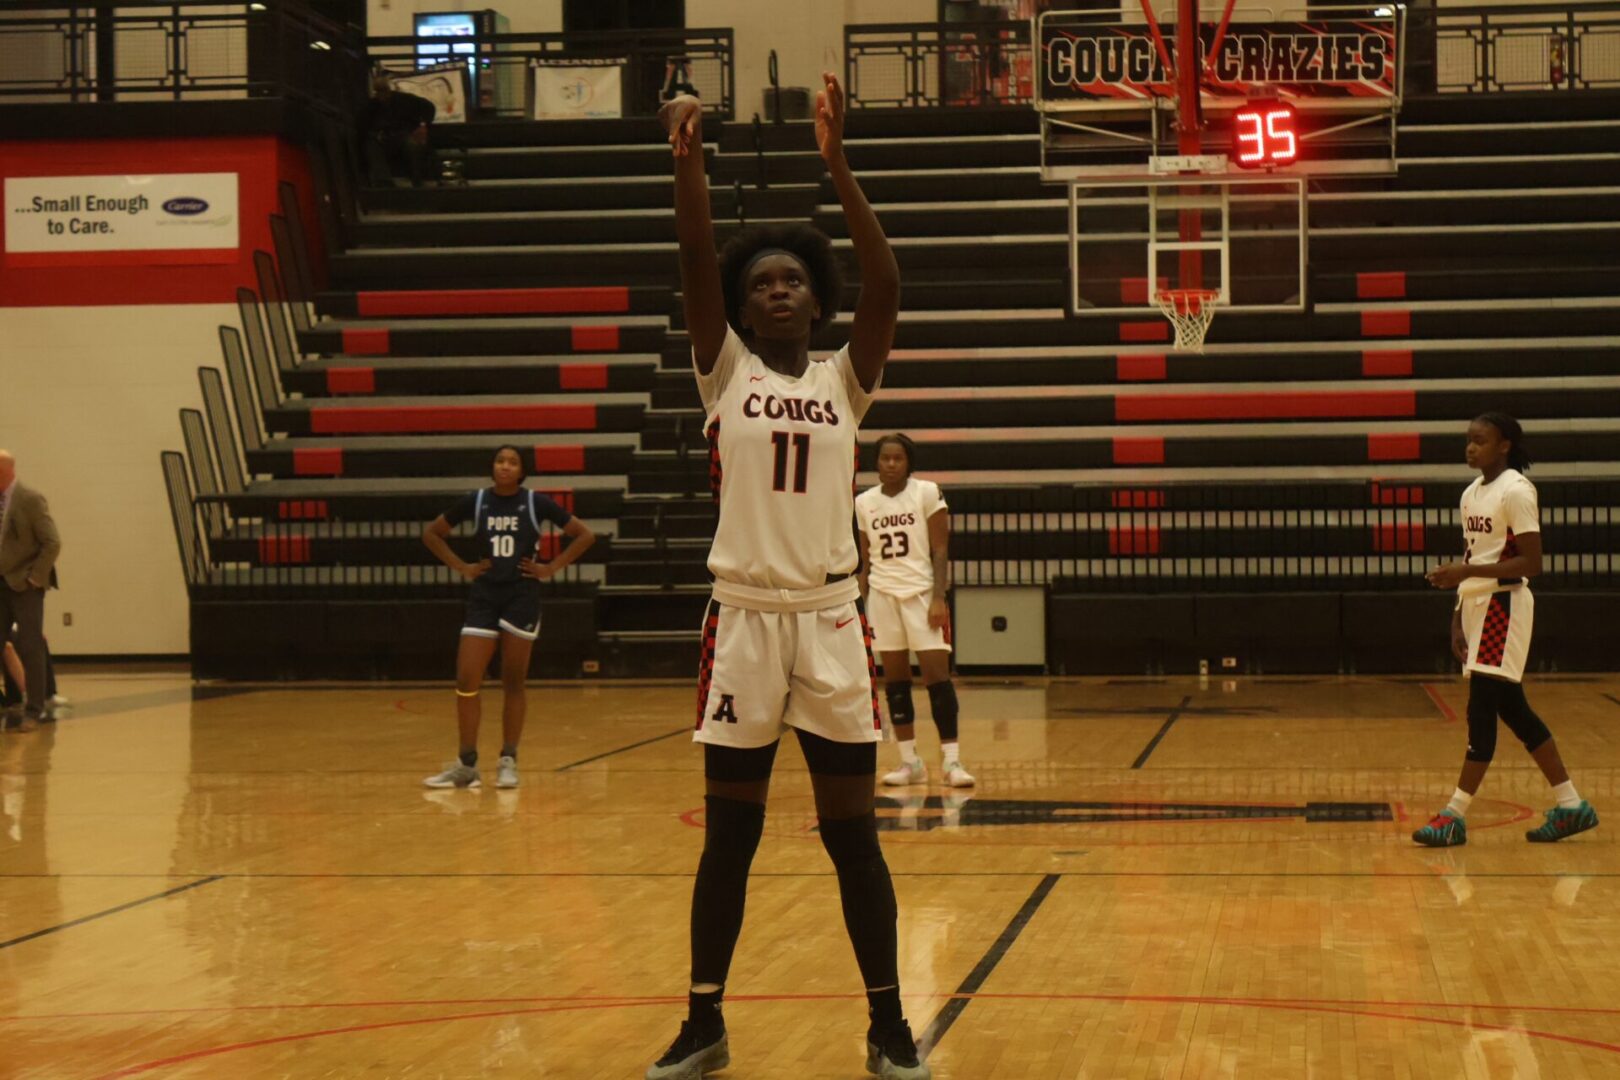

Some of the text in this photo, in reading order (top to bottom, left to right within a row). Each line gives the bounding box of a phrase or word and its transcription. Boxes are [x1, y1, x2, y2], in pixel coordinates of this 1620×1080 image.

[1048, 35, 1206, 86] COUGA
[1213, 33, 1386, 83] CRAZIES
[1236, 110, 1296, 162] 35
[86, 194, 149, 215] Enough
[167, 199, 204, 211] Carrier
[47, 217, 114, 234] to Care.
[743, 393, 839, 426] COUGS
[771, 430, 810, 494] 11
[487, 515, 519, 532] POPE
[872, 513, 915, 531] COUGS
[1465, 515, 1492, 533] OUGS
[490, 534, 515, 558] 10
[879, 531, 908, 560] 23
[712, 694, 738, 724] A
